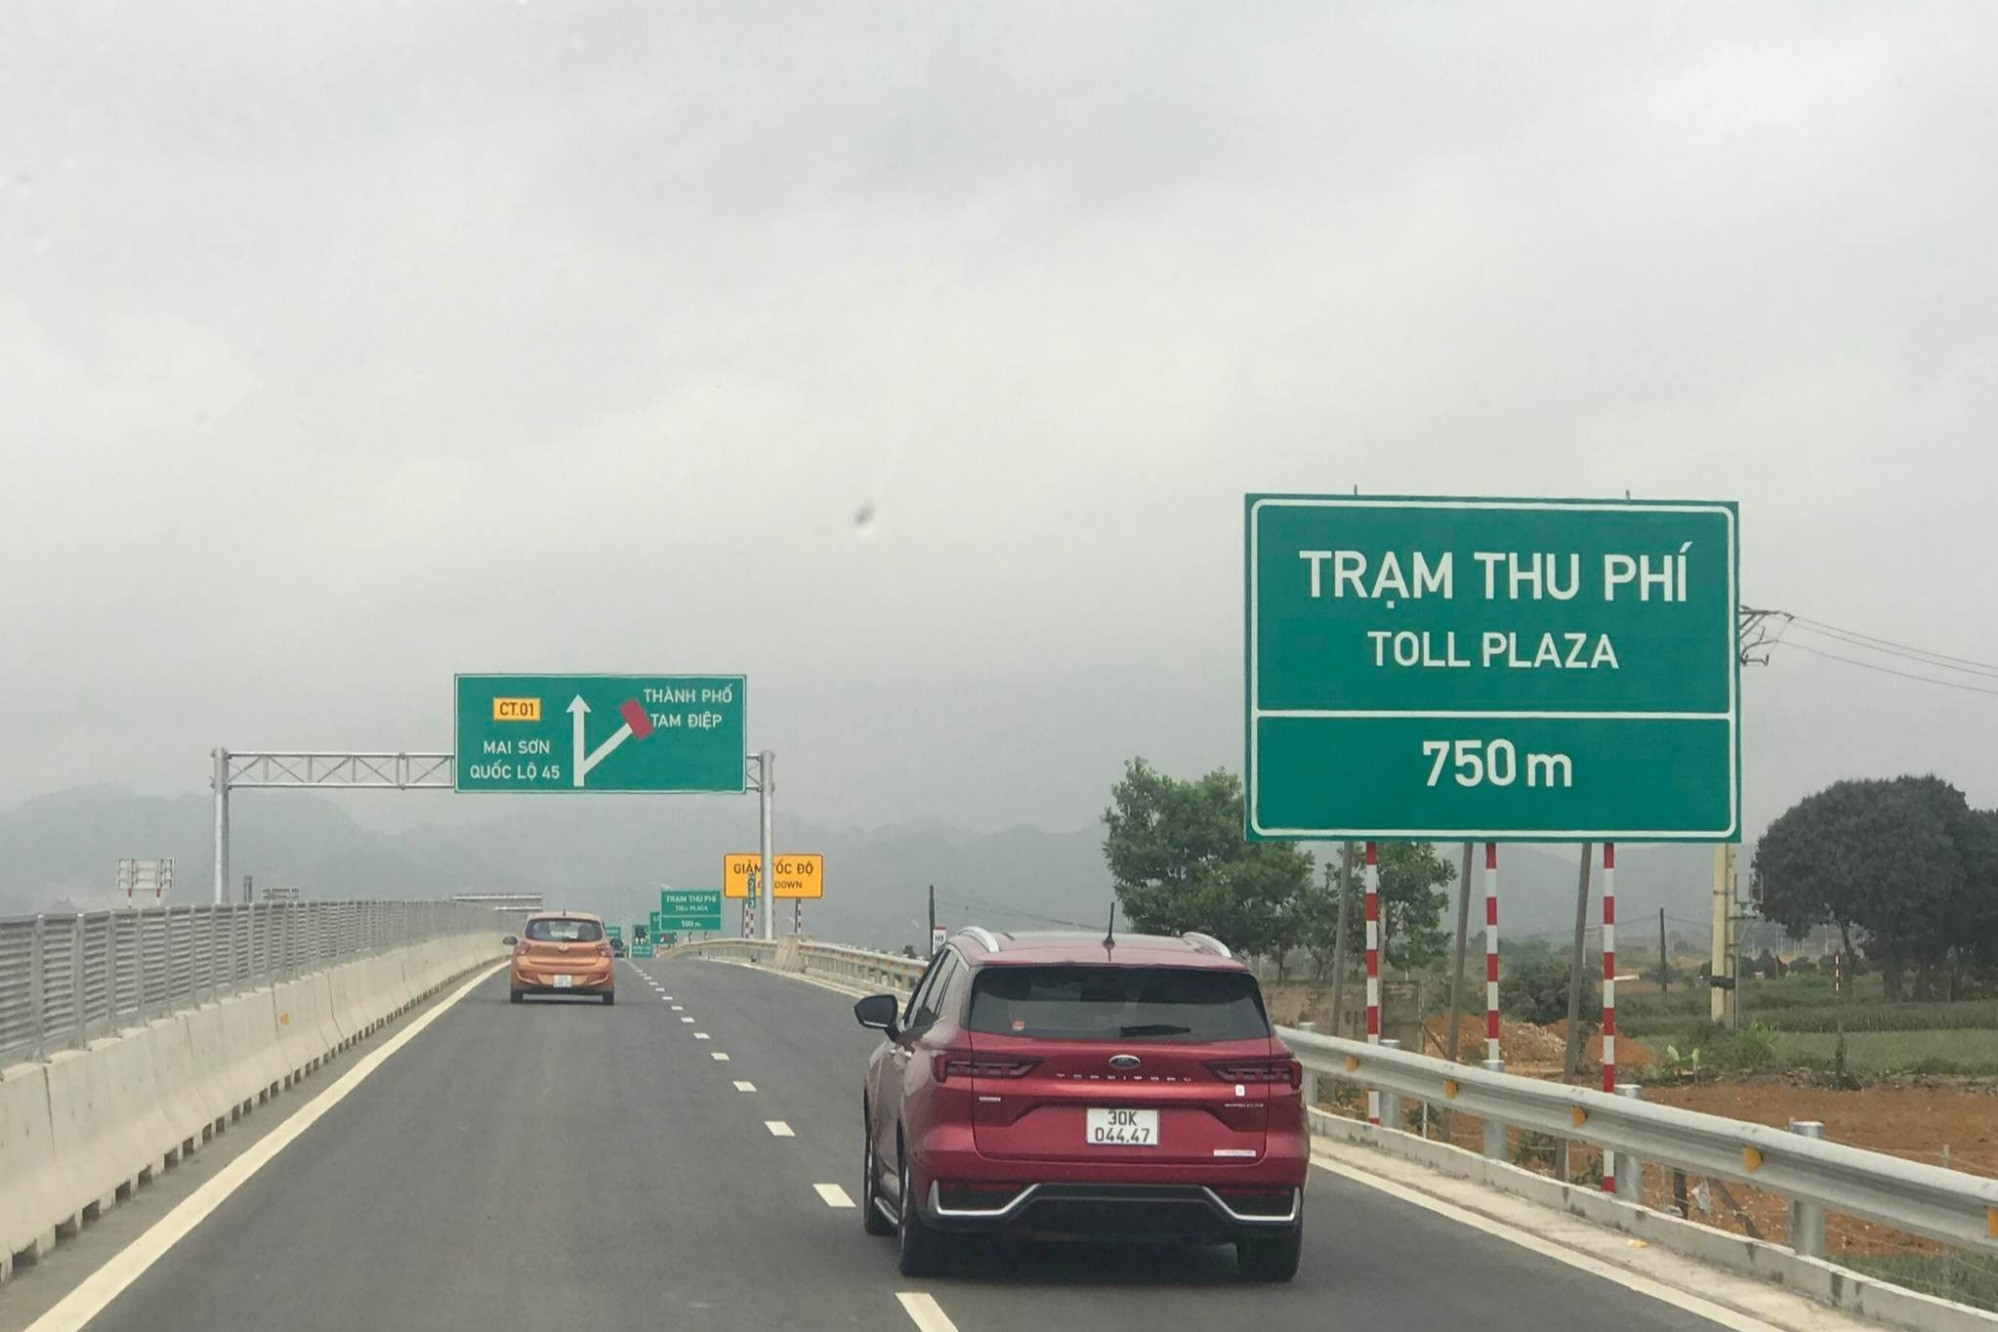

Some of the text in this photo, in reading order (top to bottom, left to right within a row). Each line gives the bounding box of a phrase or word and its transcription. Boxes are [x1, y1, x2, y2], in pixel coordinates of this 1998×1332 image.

[1299, 541, 1692, 610] TRẠM THU PHÍ
[1367, 631, 1620, 669] TOLL PLAZA
[643, 683, 733, 703] THÀNH PHỐ
[499, 702, 534, 716] CT.01
[650, 713, 722, 731] TAM ĐIỆP
[483, 739, 550, 754] MAI SƠN
[469, 759, 560, 782] QUỐC LỘ 45
[1423, 738, 1573, 788] 750 m
[773, 858, 792, 874] ỐC
[797, 861, 814, 877] ĐỘ
[1108, 1110, 1137, 1127] 30K
[1094, 1127, 1150, 1144] 044.47
